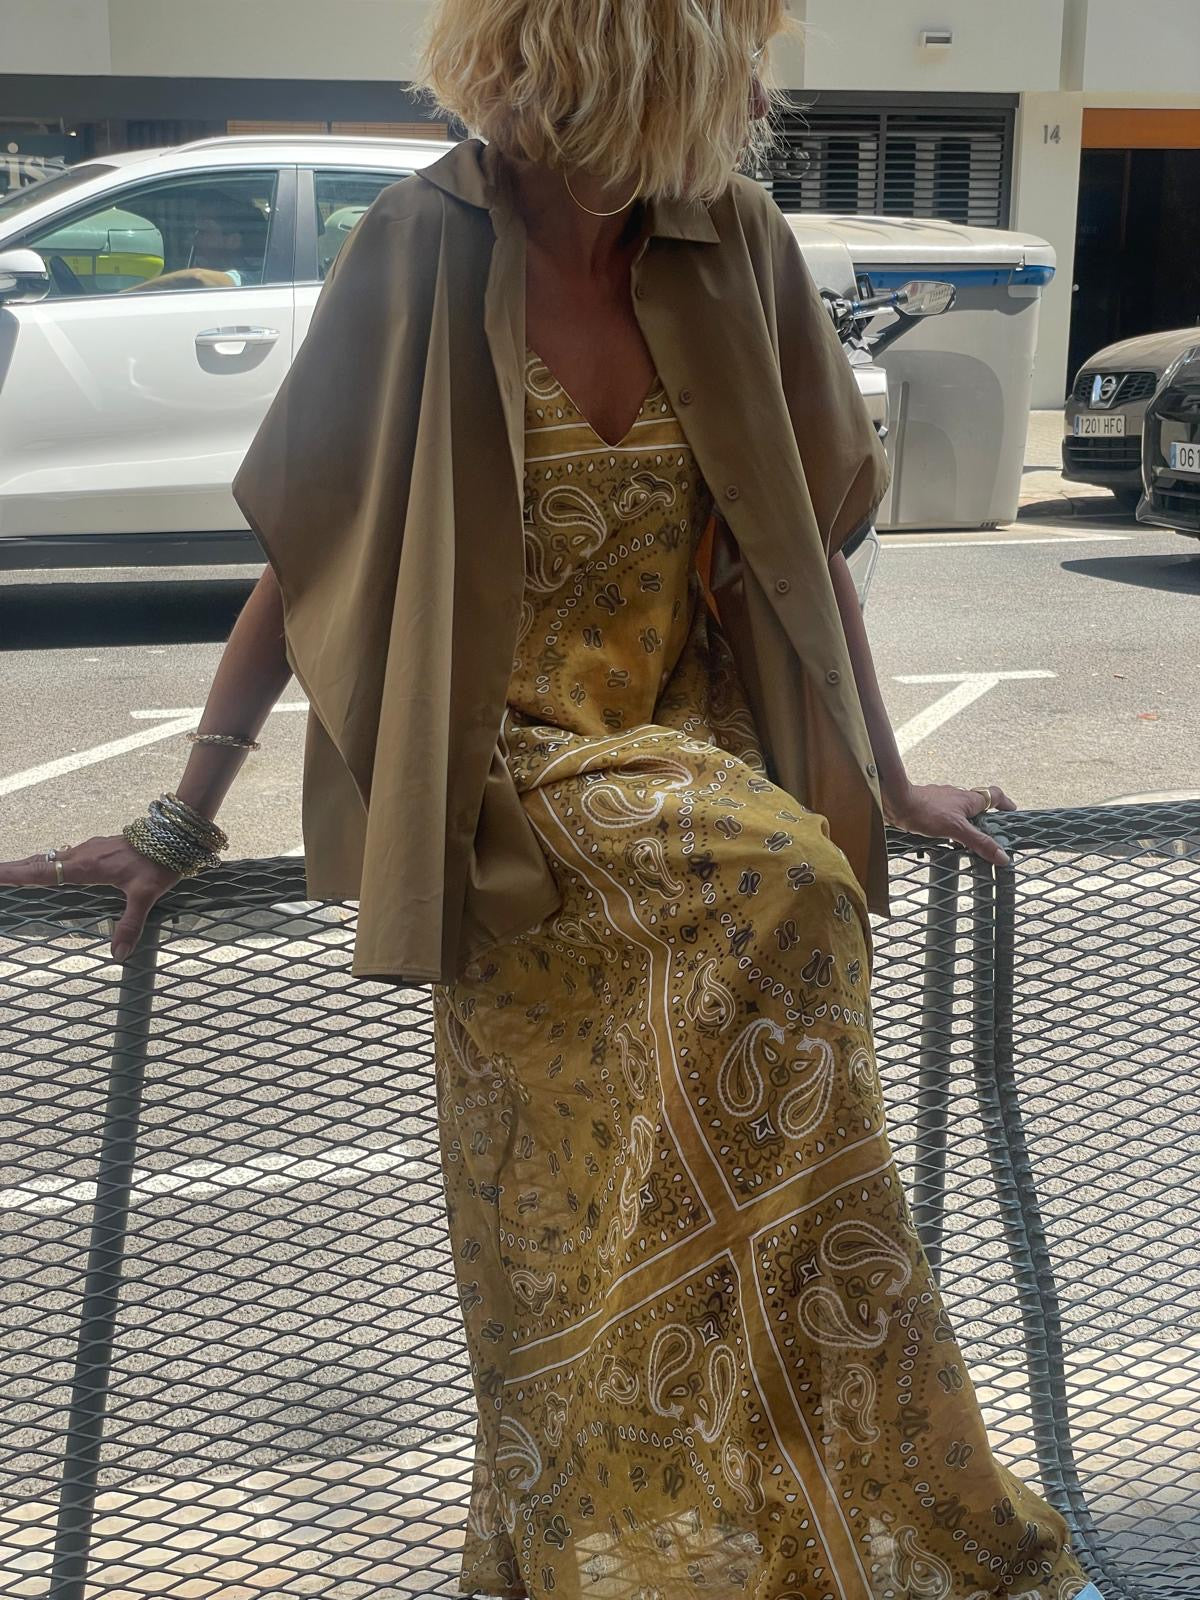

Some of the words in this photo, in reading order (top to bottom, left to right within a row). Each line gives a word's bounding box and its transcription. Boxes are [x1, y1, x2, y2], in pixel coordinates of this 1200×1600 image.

[1044, 125, 1061, 144] 14
[0, 142, 48, 189] is
[1080, 417, 1100, 434] 1201
